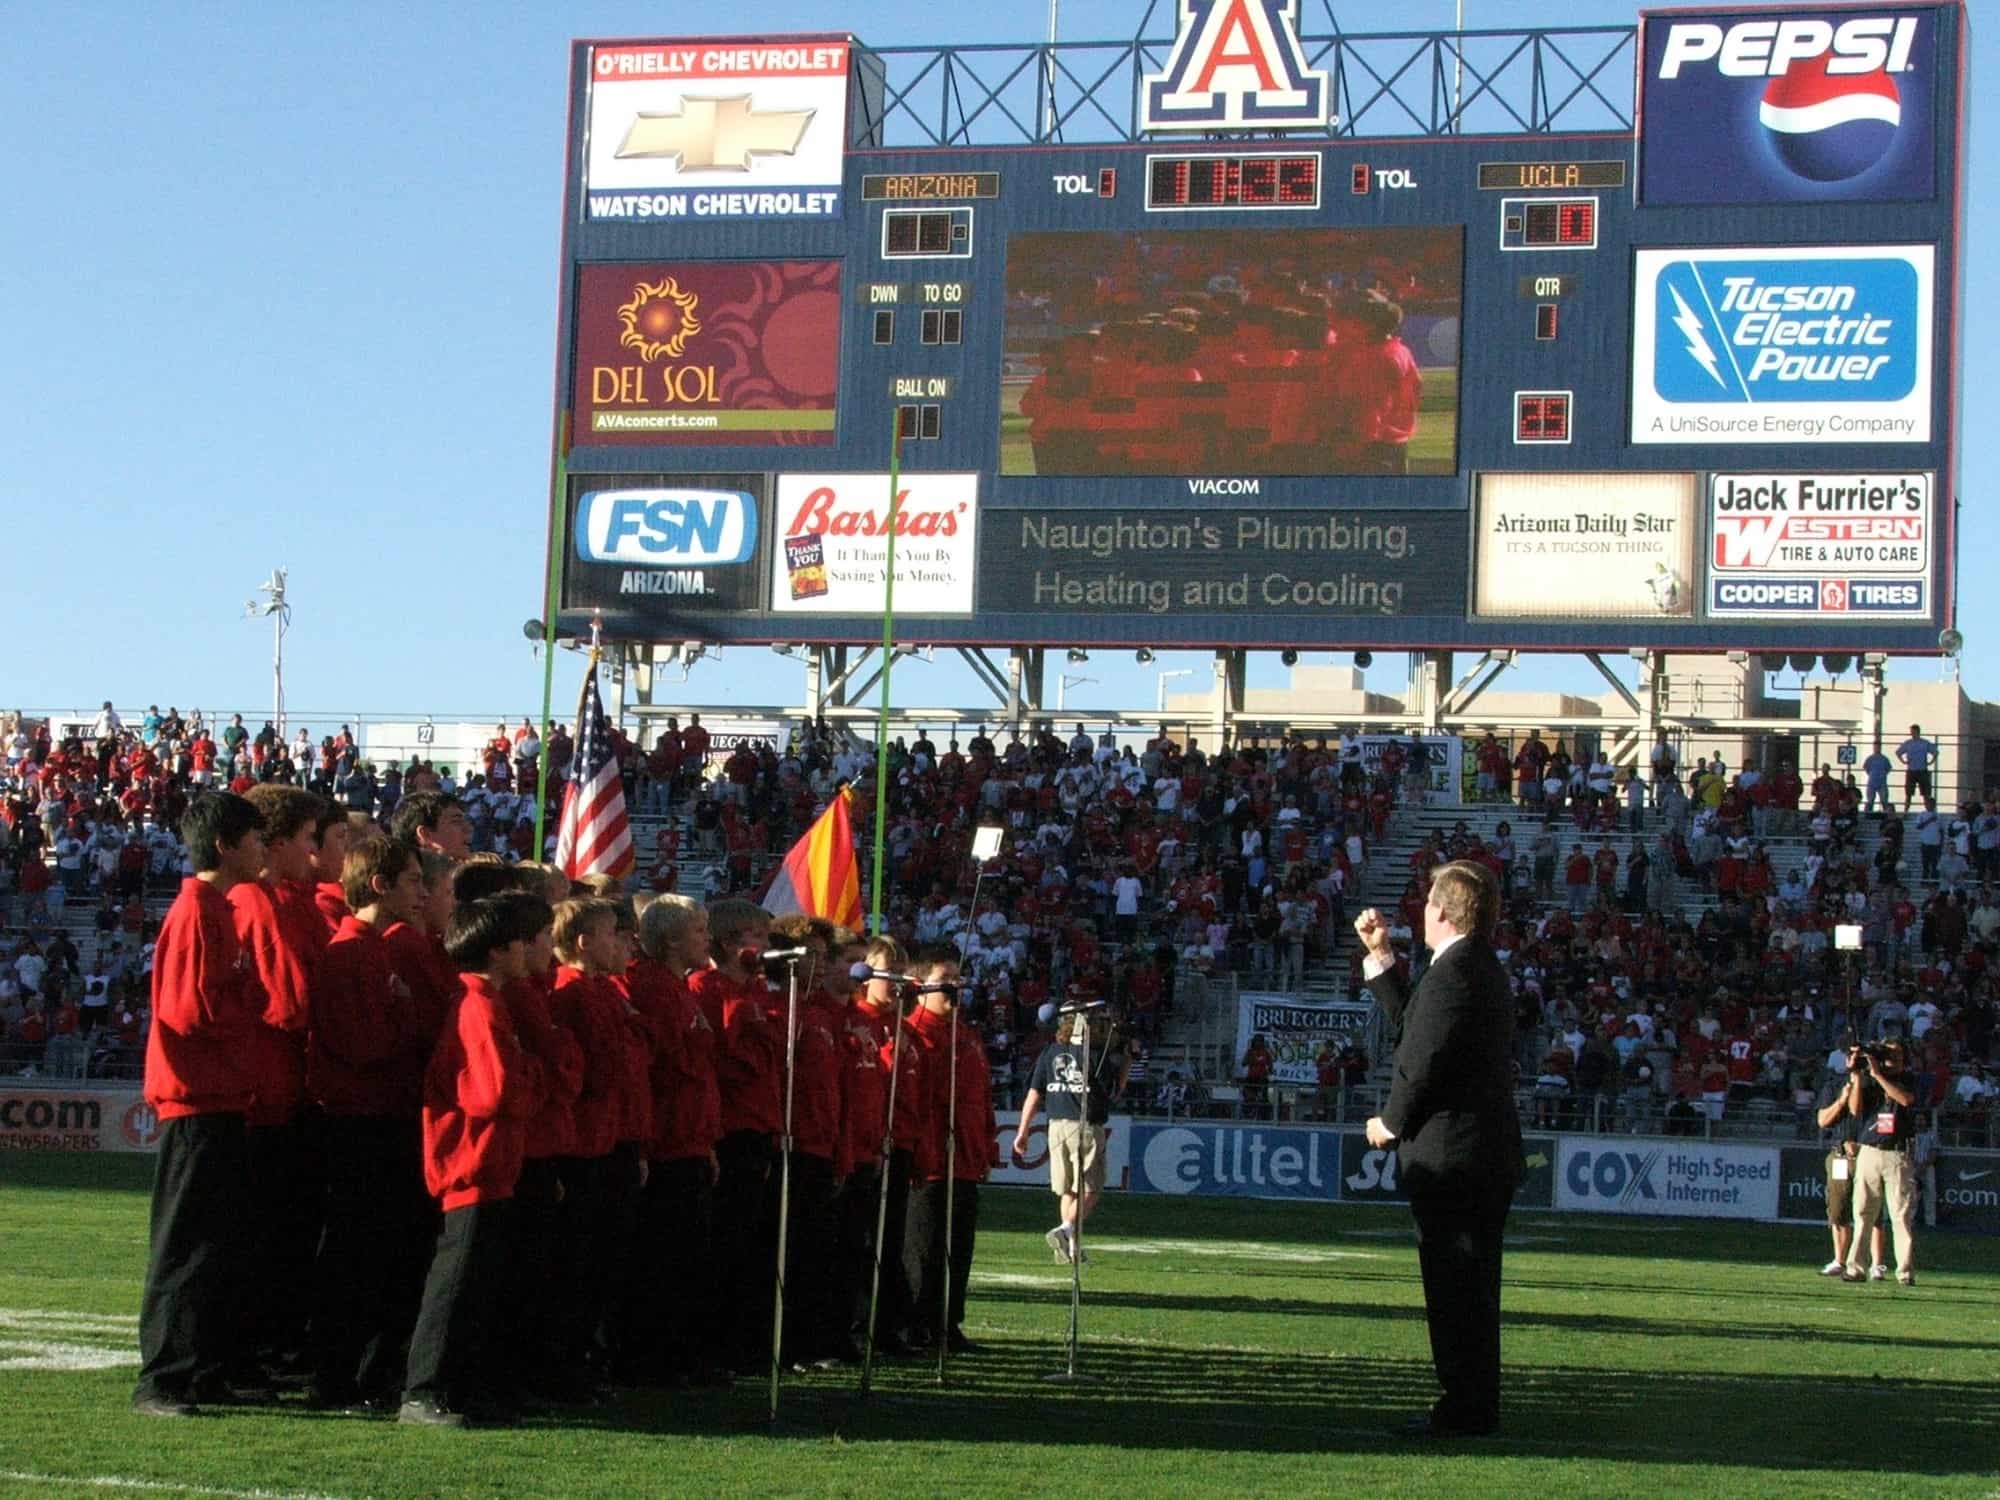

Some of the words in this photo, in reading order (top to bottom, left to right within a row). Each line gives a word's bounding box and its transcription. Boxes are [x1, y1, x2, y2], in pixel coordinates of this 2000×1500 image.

[1658, 17, 1919, 80] PEPSI
[596, 51, 696, 75] O'RIELLY
[703, 48, 844, 72] CHEVROLET
[885, 176, 977, 199] ARIZONA
[1052, 175, 1094, 194] TOL
[1374, 169, 1418, 190] TOL
[1520, 165, 1580, 188] UCLA
[590, 195, 687, 217] WATSON
[693, 193, 837, 215] CHEVROLET
[870, 285, 898, 302] DWN
[924, 284, 940, 302] TO
[943, 284, 962, 301] GO
[1535, 277, 1561, 296] QTR
[1720, 277, 1856, 312] Tucson
[1732, 312, 1892, 346] Electric
[1748, 348, 1890, 381] Power
[592, 367, 648, 403] DEL
[664, 366, 721, 403] SOL
[896, 379, 925, 396] BALL
[928, 379, 946, 396] ON
[596, 414, 718, 428] AVAconcerts.com
[1651, 417, 1664, 432] A
[1670, 416, 1759, 433] UniSource
[1763, 415, 1825, 435] Energy
[1829, 415, 1916, 435] Company
[1188, 479, 1260, 495] VIACOM
[1718, 479, 1788, 511] Jack
[1798, 479, 1921, 511] Furrier's
[603, 499, 729, 554] FSN
[1494, 513, 1570, 533] Arizona
[1575, 513, 1627, 537] Daily
[1632, 512, 1676, 533] Star
[1021, 516, 1222, 558] Naughton's
[1237, 516, 1416, 560] Plumbing,
[1535, 542, 1547, 553] A
[1551, 541, 1611, 553] TUCSON
[1615, 541, 1664, 553] THING
[1716, 514, 1922, 567] WESTERN
[793, 552, 819, 567] YOU
[854, 549, 901, 561] Thans
[906, 549, 931, 561] You
[935, 549, 952, 565] By
[1781, 547, 1813, 561] TIRE
[1818, 547, 1828, 560] &
[1833, 547, 1874, 561] AUTO
[1879, 547, 1918, 560] CARE
[620, 571, 705, 595] ARIZONA
[831, 569, 875, 583] Saving
[1034, 570, 1170, 613] Heating
[1183, 573, 1250, 606] and
[1261, 572, 1404, 615] Cooling
[1720, 584, 1814, 604] COOPER
[1852, 585, 1918, 604] TIRES
[1255, 1007, 1366, 1030] BRUEGGER'S
[1175, 1128, 1323, 1188] alltel
[1567, 1150, 1661, 1201] COX
[1667, 1155, 1709, 1181] High
[1713, 1157, 1771, 1184] Speed
[1789, 1176, 1827, 1197] nik
[1667, 1182, 1740, 1205] Internet
